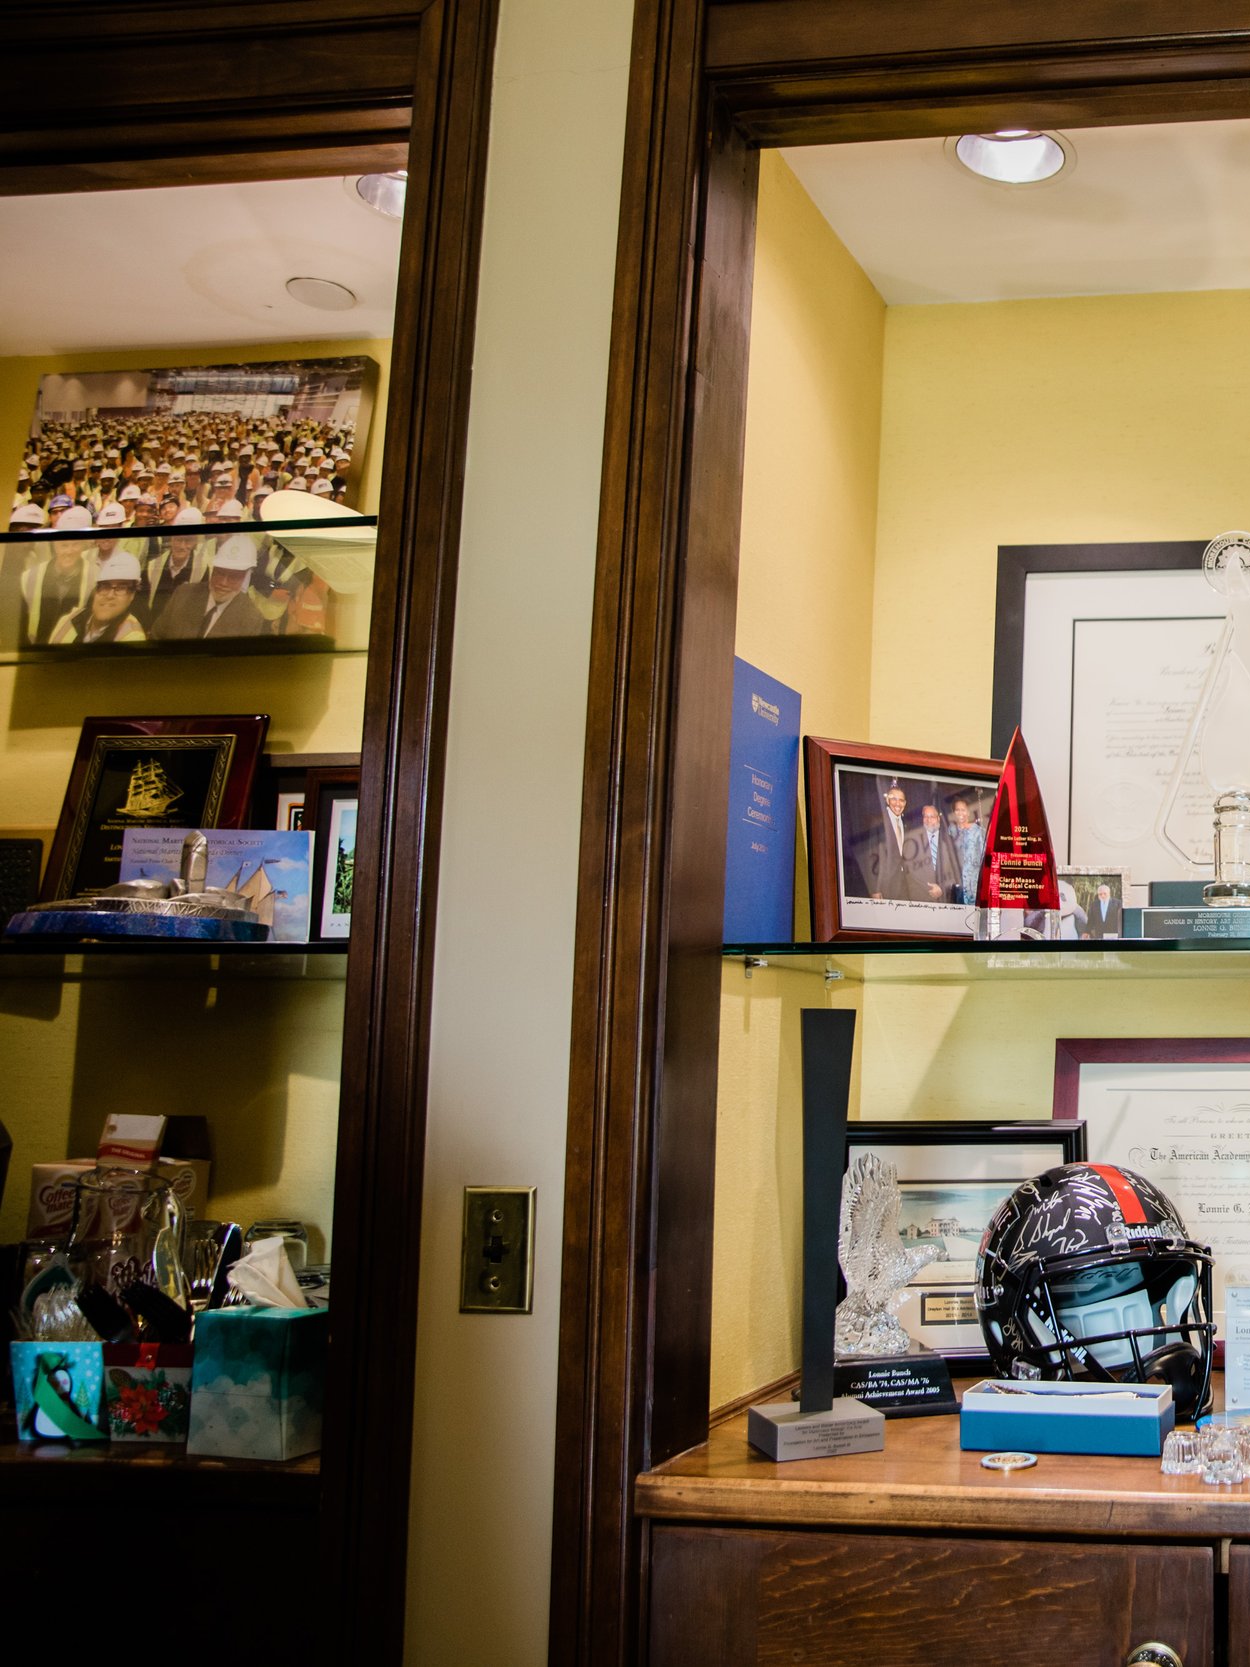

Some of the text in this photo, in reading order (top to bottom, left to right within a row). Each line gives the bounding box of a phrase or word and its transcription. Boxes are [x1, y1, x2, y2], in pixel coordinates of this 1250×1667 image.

[752, 773, 774, 794] Honorary
[753, 791, 771, 806] Degree
[1149, 1146, 1167, 1161] The
[1169, 1149, 1209, 1161] American
[1213, 1149, 1250, 1163] Academy
[40, 1185, 77, 1208] Coffee
[46, 1198, 74, 1213] mate
[1197, 1202, 1230, 1215] Lonnie
[1232, 1203, 1245, 1215] G.
[868, 1368, 912, 1379] Lonnie Bunch
[850, 1380, 878, 1390] CAS/BA
[890, 1377, 920, 1387] CAS/MA
[864, 1389, 905, 1400] Achievement
[905, 1387, 925, 1397] Award
[925, 1386, 941, 1394] 2005
